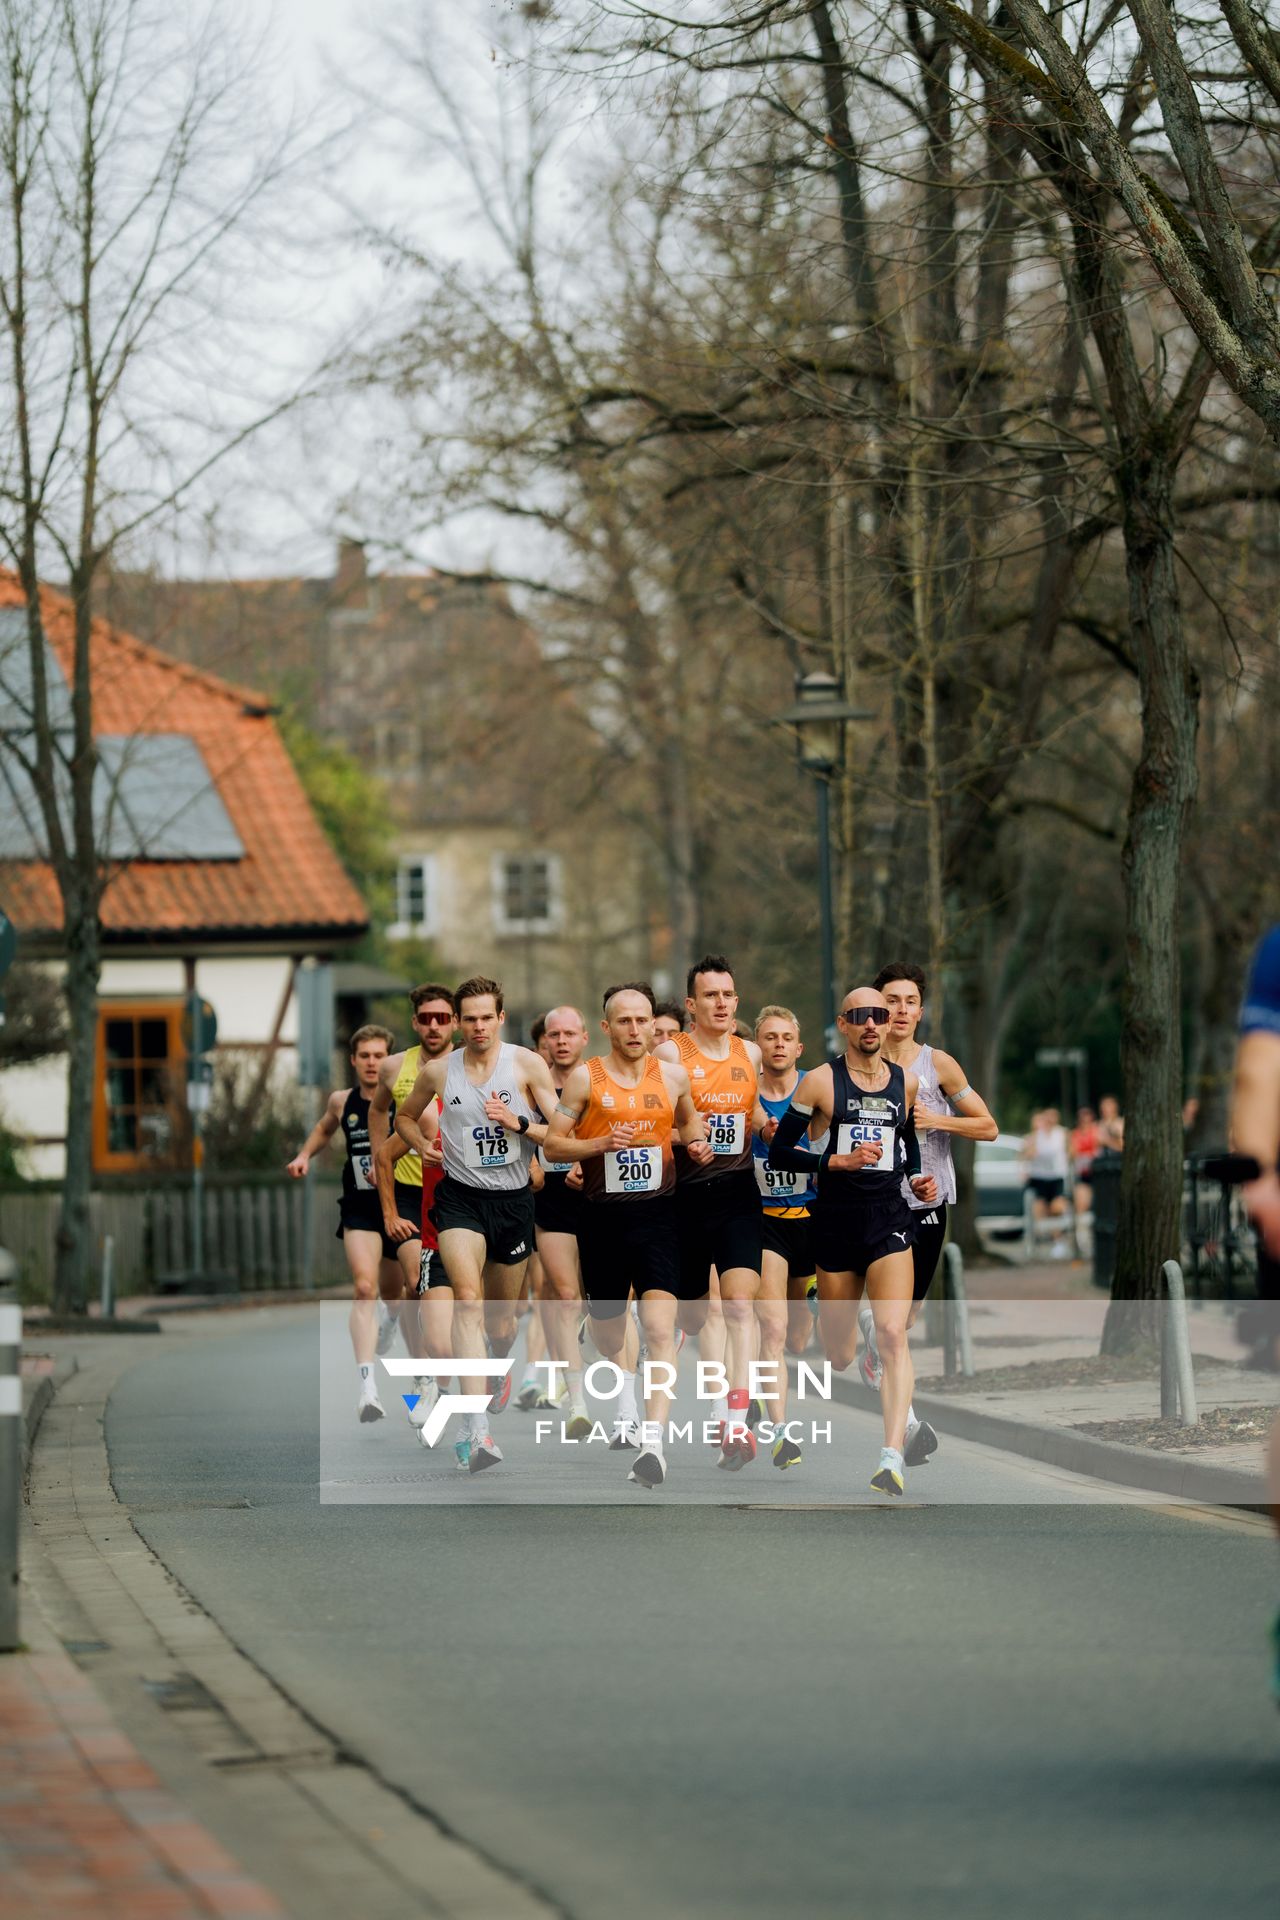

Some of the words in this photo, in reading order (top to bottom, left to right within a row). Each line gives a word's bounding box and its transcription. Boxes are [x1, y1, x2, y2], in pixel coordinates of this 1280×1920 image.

[700, 1093, 742, 1104] VIACTIV
[472, 1126, 505, 1140] GLS
[850, 1127, 882, 1141] GLS
[476, 1139, 508, 1156] 178
[616, 1149, 649, 1164] GLS
[618, 1163, 651, 1181] 200
[765, 1171, 797, 1187] 910
